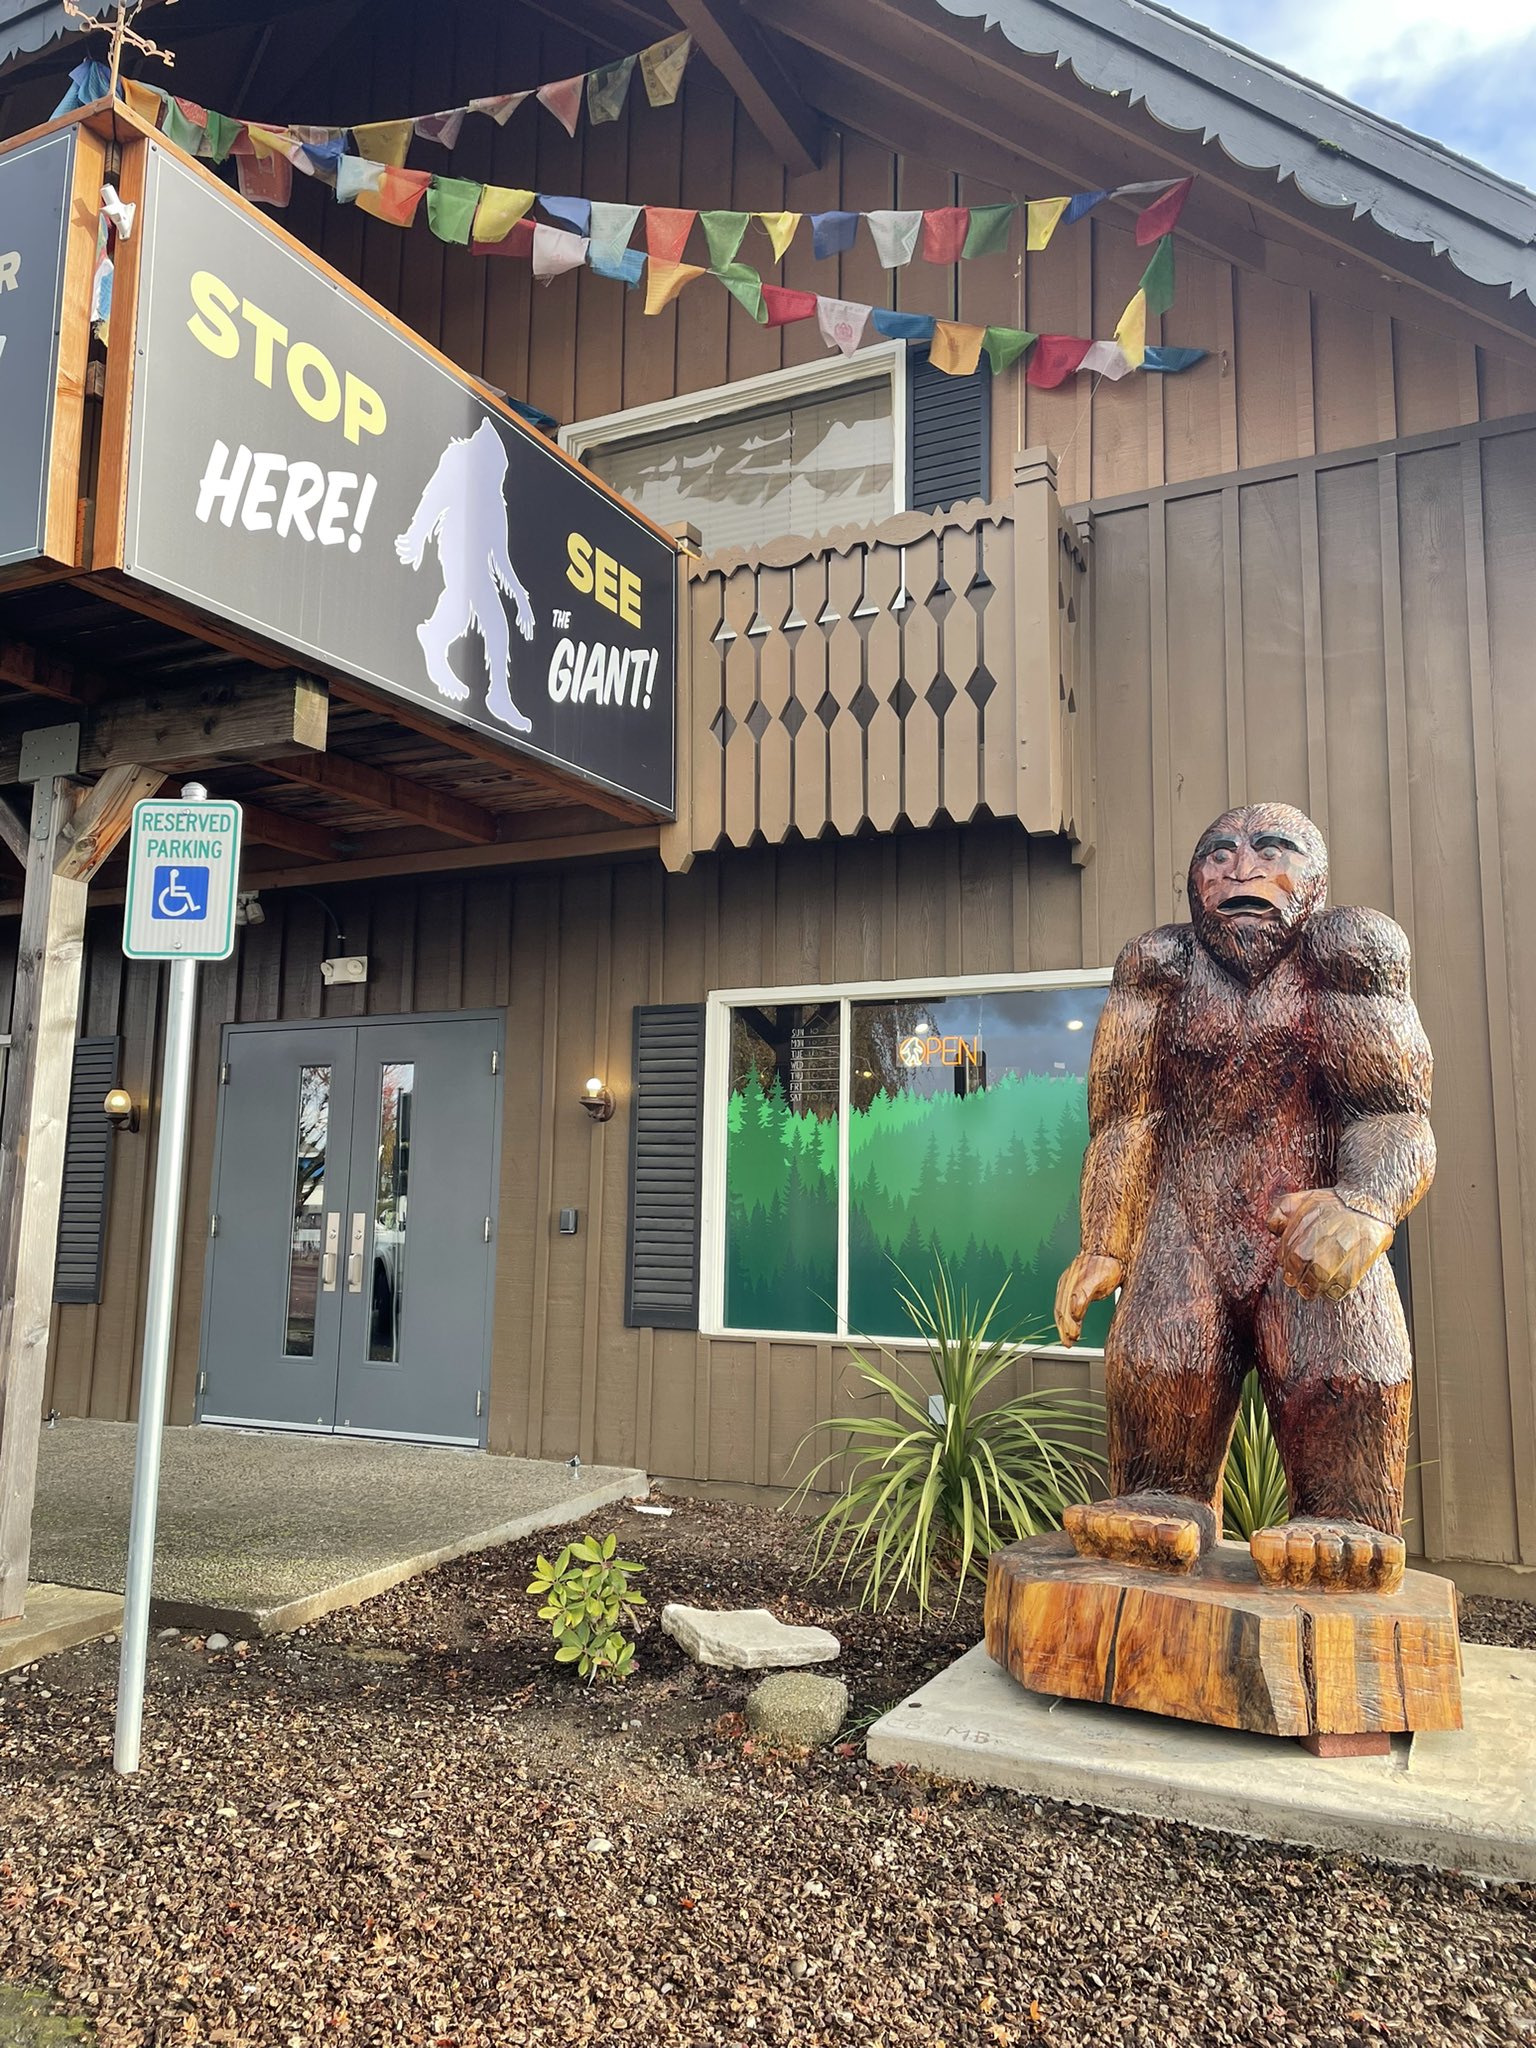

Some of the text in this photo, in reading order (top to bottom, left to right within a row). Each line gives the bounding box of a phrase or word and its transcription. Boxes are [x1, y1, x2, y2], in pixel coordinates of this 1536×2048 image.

[186, 270, 387, 446] STOP
[195, 438, 378, 553] HERE!
[566, 532, 642, 629] SEE
[552, 609, 572, 629] THE
[548, 637, 659, 710] GIANT!
[142, 813, 231, 832] RESERVED
[147, 839, 222, 859] PARKING
[791, 1028, 804, 1037] SUN
[790, 1039, 804, 1048] MON
[899, 1036, 977, 1067] OPEN
[791, 1050, 804, 1059] TUE
[790, 1061, 804, 1070] WED
[790, 1072, 804, 1080] THU
[790, 1082, 803, 1091] FRI
[790, 1093, 803, 1102] SAT
